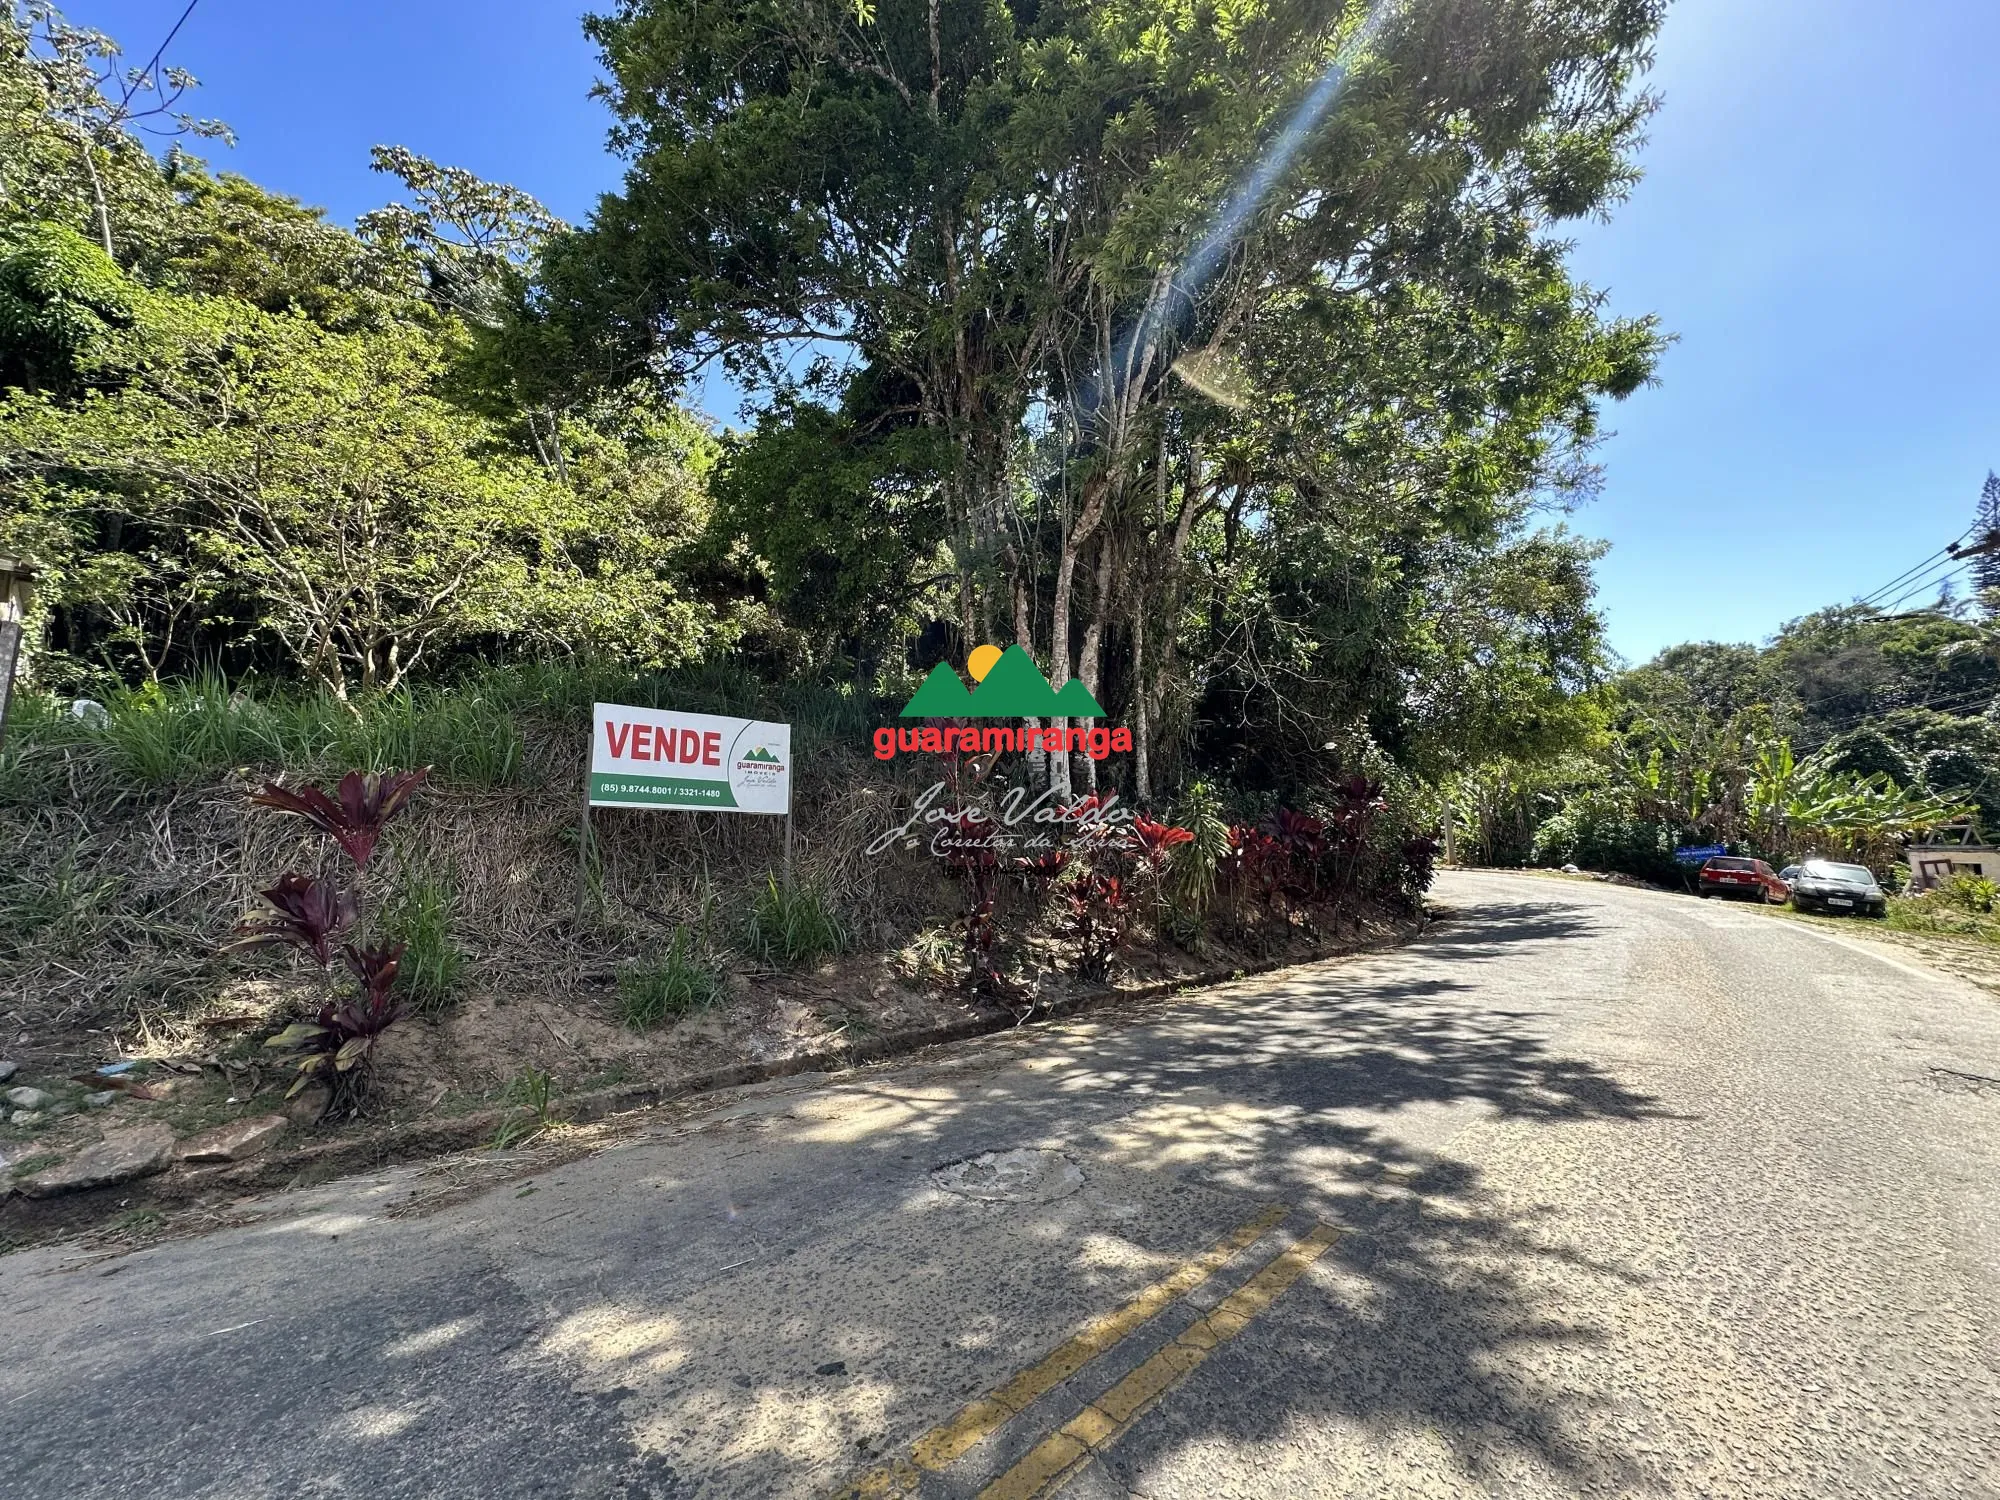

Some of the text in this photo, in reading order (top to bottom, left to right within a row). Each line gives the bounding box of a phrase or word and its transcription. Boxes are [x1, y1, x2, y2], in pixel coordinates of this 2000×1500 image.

[605, 721, 721, 766] VENDE
[737, 761, 785, 772] guaramiranga
[600, 783, 619, 793] (85)
[620, 785, 672, 795] 9.8744.8001
[679, 787, 721, 798] 3321-1480
